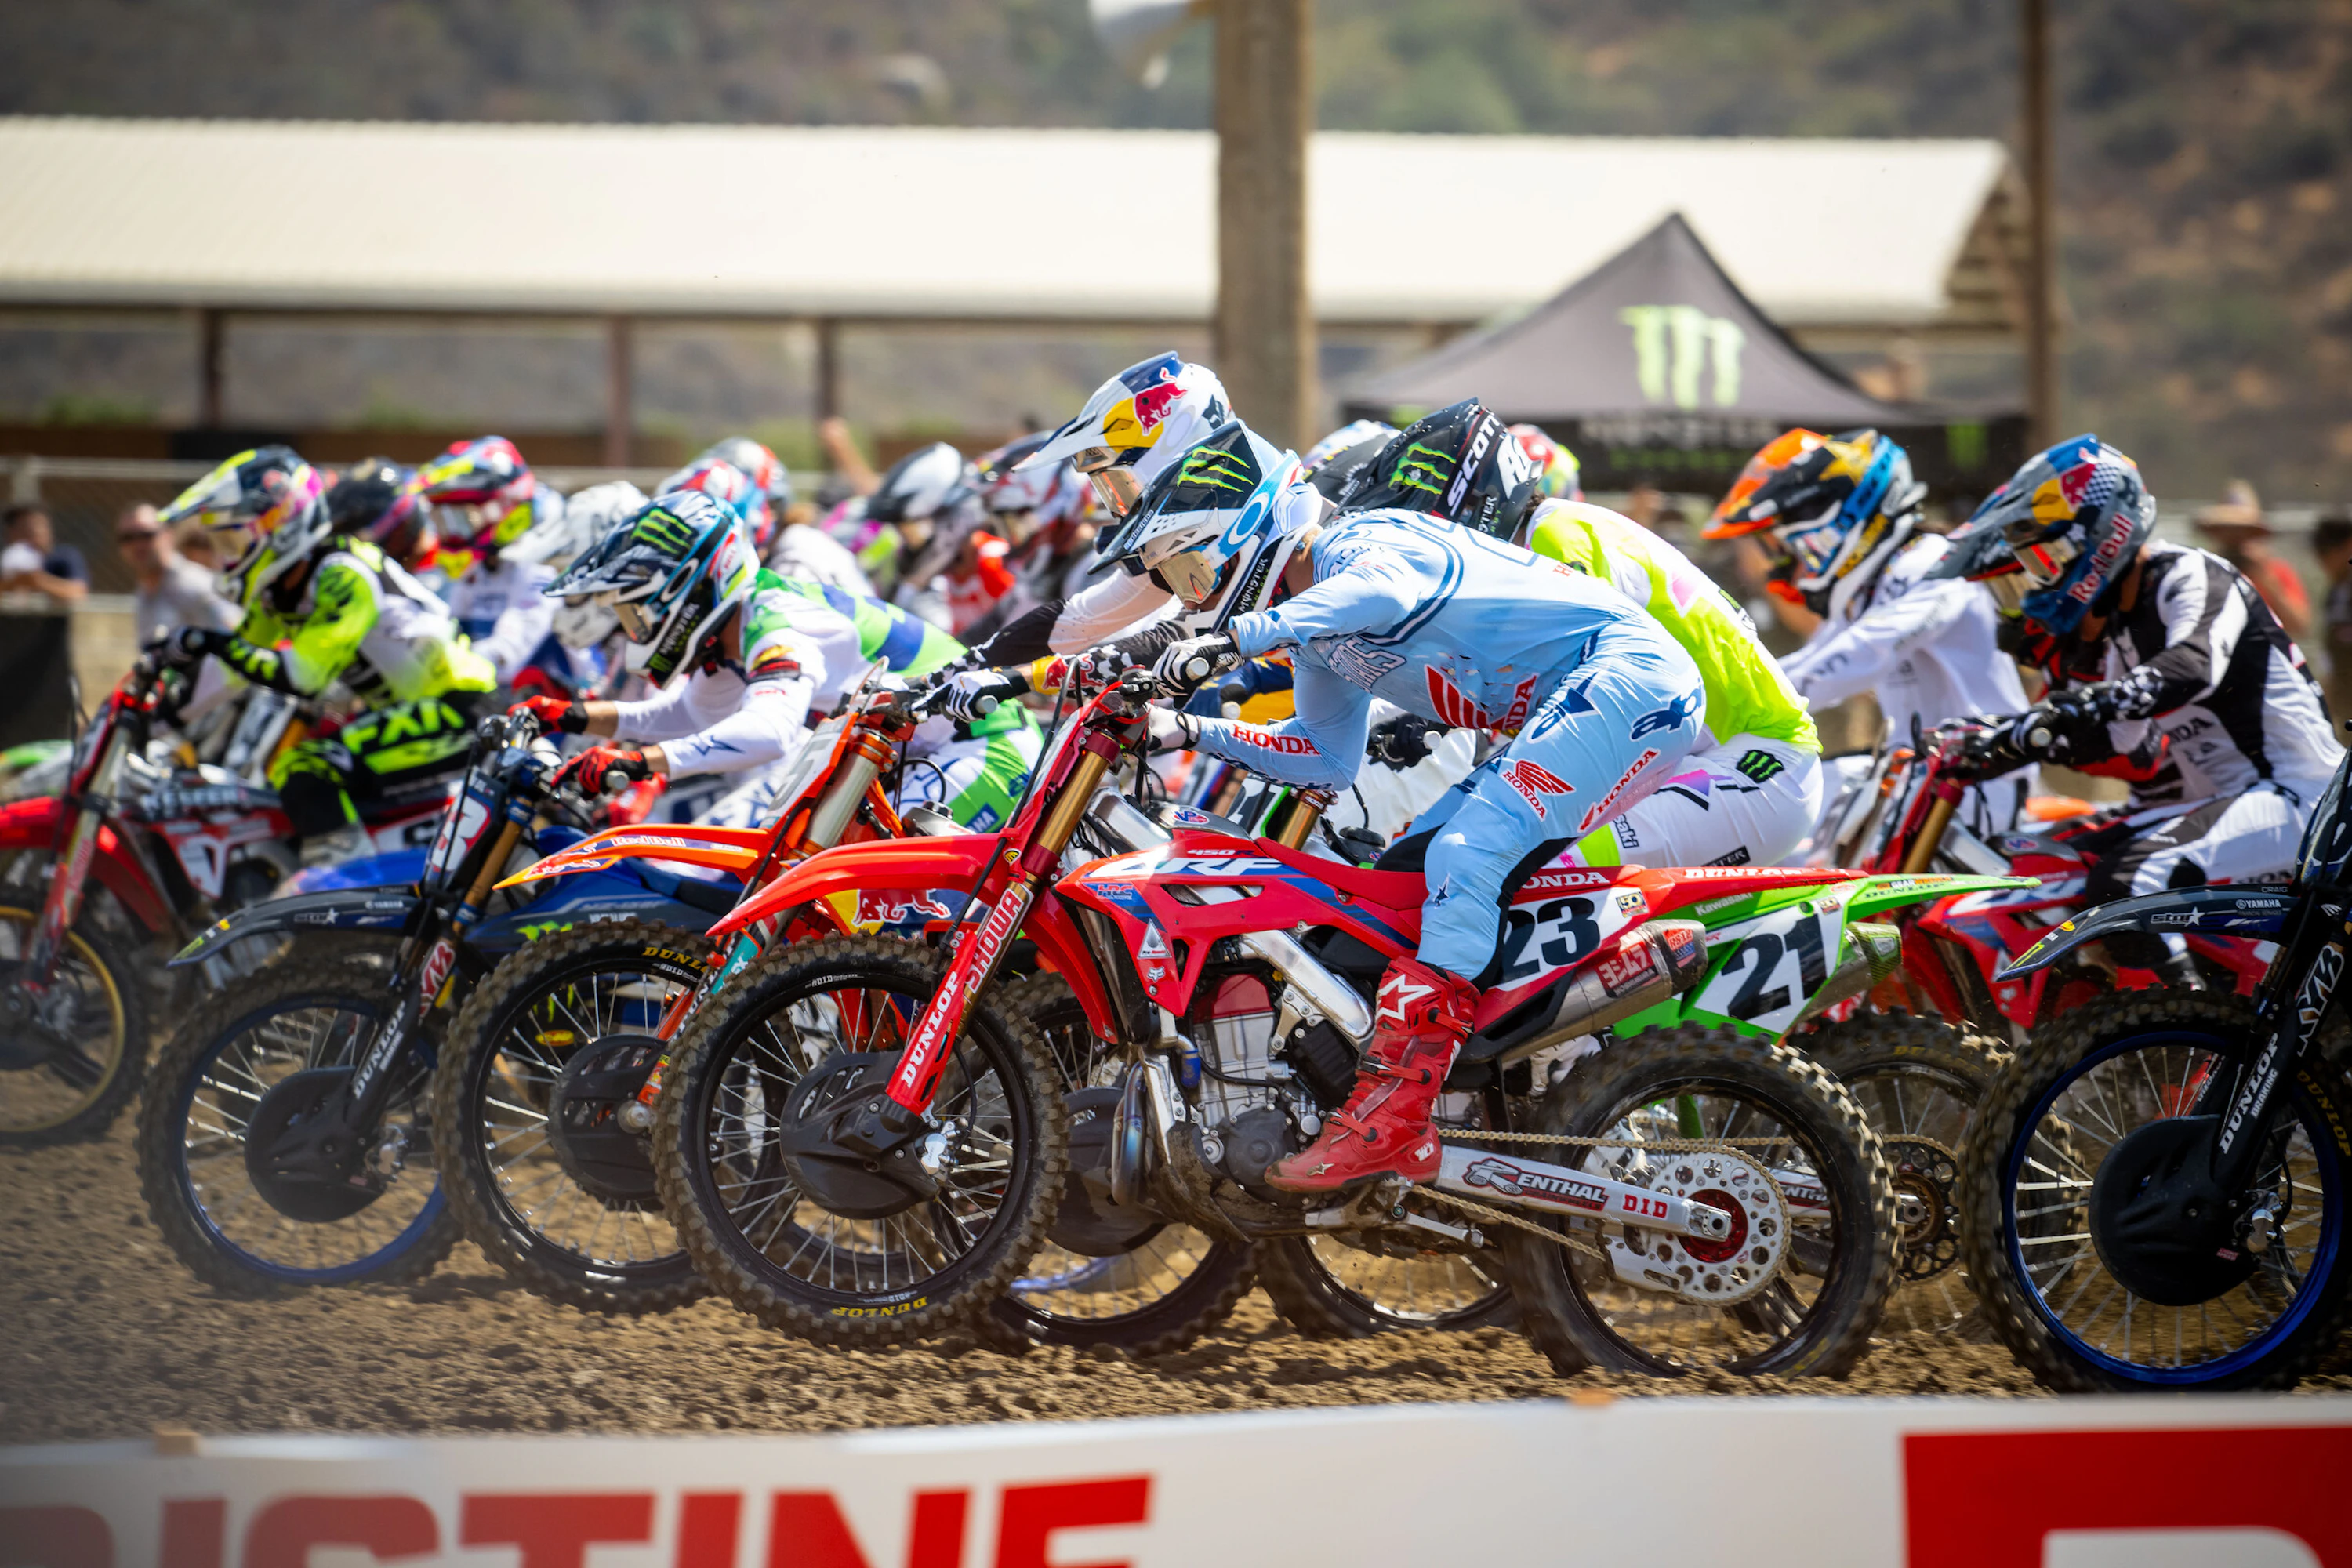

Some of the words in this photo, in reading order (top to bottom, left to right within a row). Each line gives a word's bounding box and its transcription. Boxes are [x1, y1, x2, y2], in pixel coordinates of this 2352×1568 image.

[1238, 557, 1269, 612] MONSTER
[343, 699, 465, 754] FXR
[1501, 673, 1538, 730] NDA
[1231, 724, 1321, 756] HONDA
[1501, 770, 1547, 820] HONDA
[1596, 749, 1660, 815] HONDA
[1614, 814, 1640, 848] saki
[1098, 884, 1133, 897] HRC
[1521, 872, 1610, 889] ONDA
[1694, 891, 1754, 916] Kawasaki
[2247, 899, 2281, 908] YAMAHA
[964, 888, 1026, 994] SHOWA
[1501, 896, 1601, 984] 23
[1720, 913, 1828, 1022] 21
[354, 1000, 407, 1100] DUNLOP
[901, 971, 959, 1088] DUNLOP
[2218, 1032, 2279, 1155] DUNLOP
[2250, 1068, 2278, 1120] BRAKING
[2297, 1069, 2351, 1157] DUNLOP
[1464, 1160, 1606, 1203] RENTHAL
[1622, 1194, 1668, 1219] D.I.D
[831, 1296, 928, 1318] DUNLOP
[0, 1477, 1153, 1568] ISTINE
